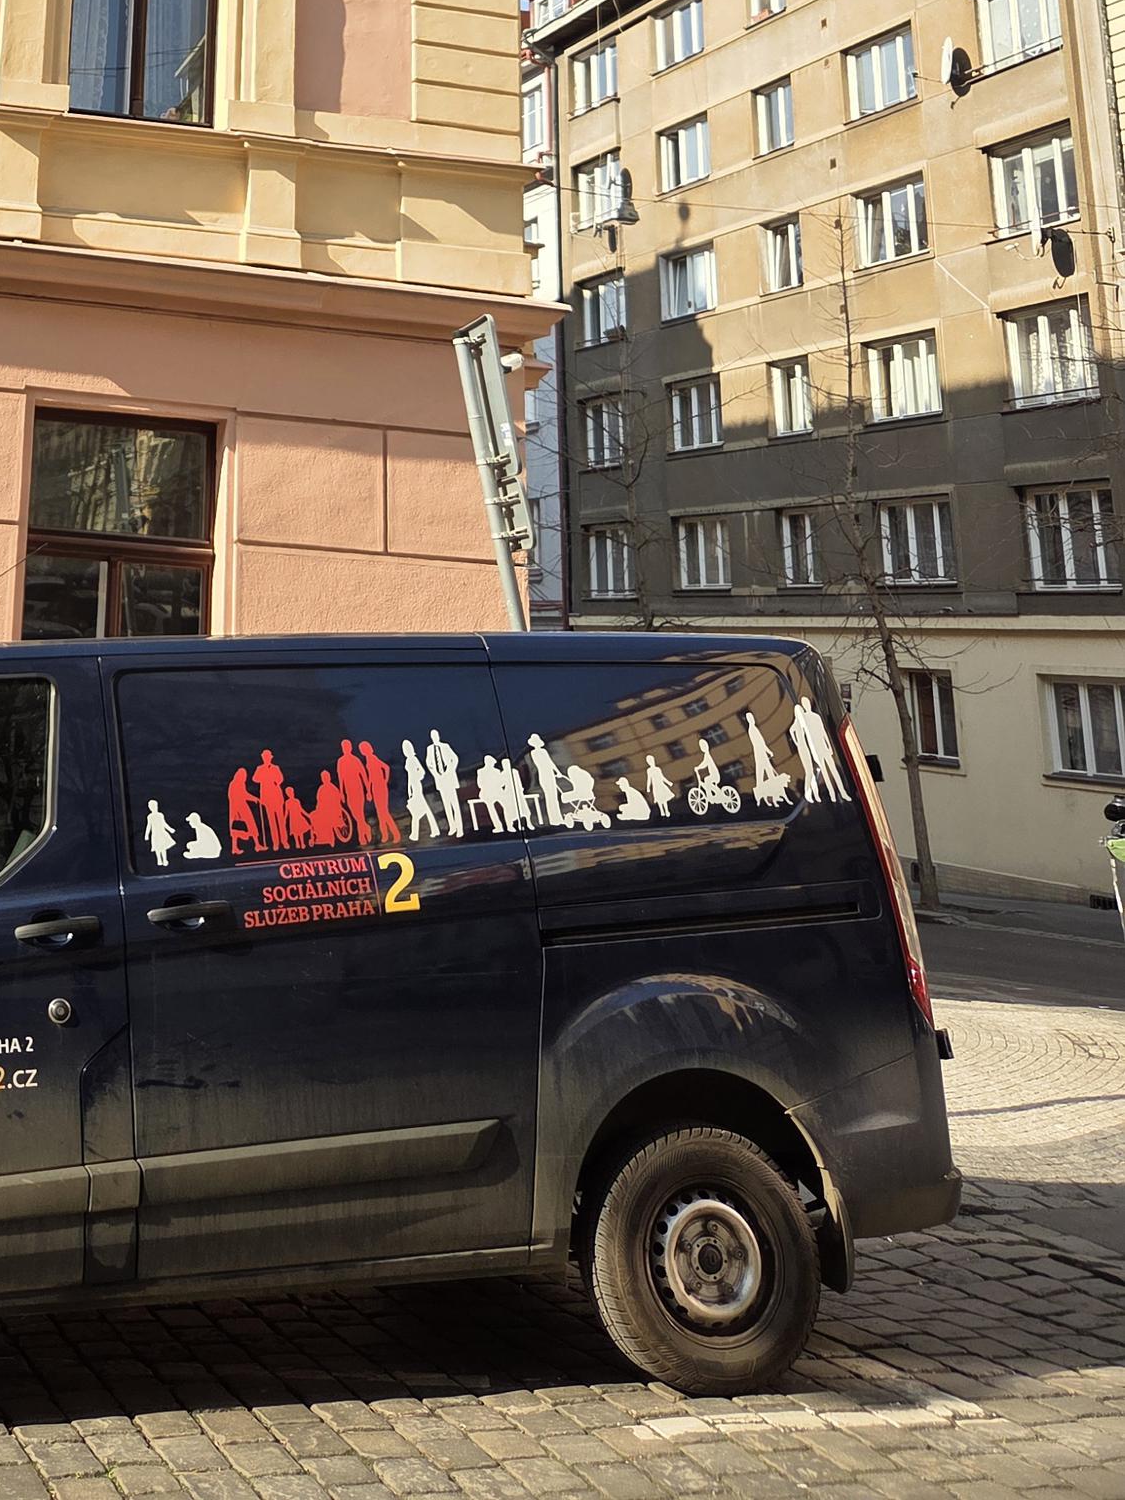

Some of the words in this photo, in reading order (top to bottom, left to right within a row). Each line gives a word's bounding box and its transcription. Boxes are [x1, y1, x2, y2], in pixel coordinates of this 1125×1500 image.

[278, 856, 369, 880] CENTRUM
[262, 876, 373, 904] SOCIÁLNÍCH
[377, 852, 421, 914] 2
[243, 902, 310, 929] SLUŽEB
[312, 900, 375, 921] PRAHA
[25, 1035, 35, 1052] 2
